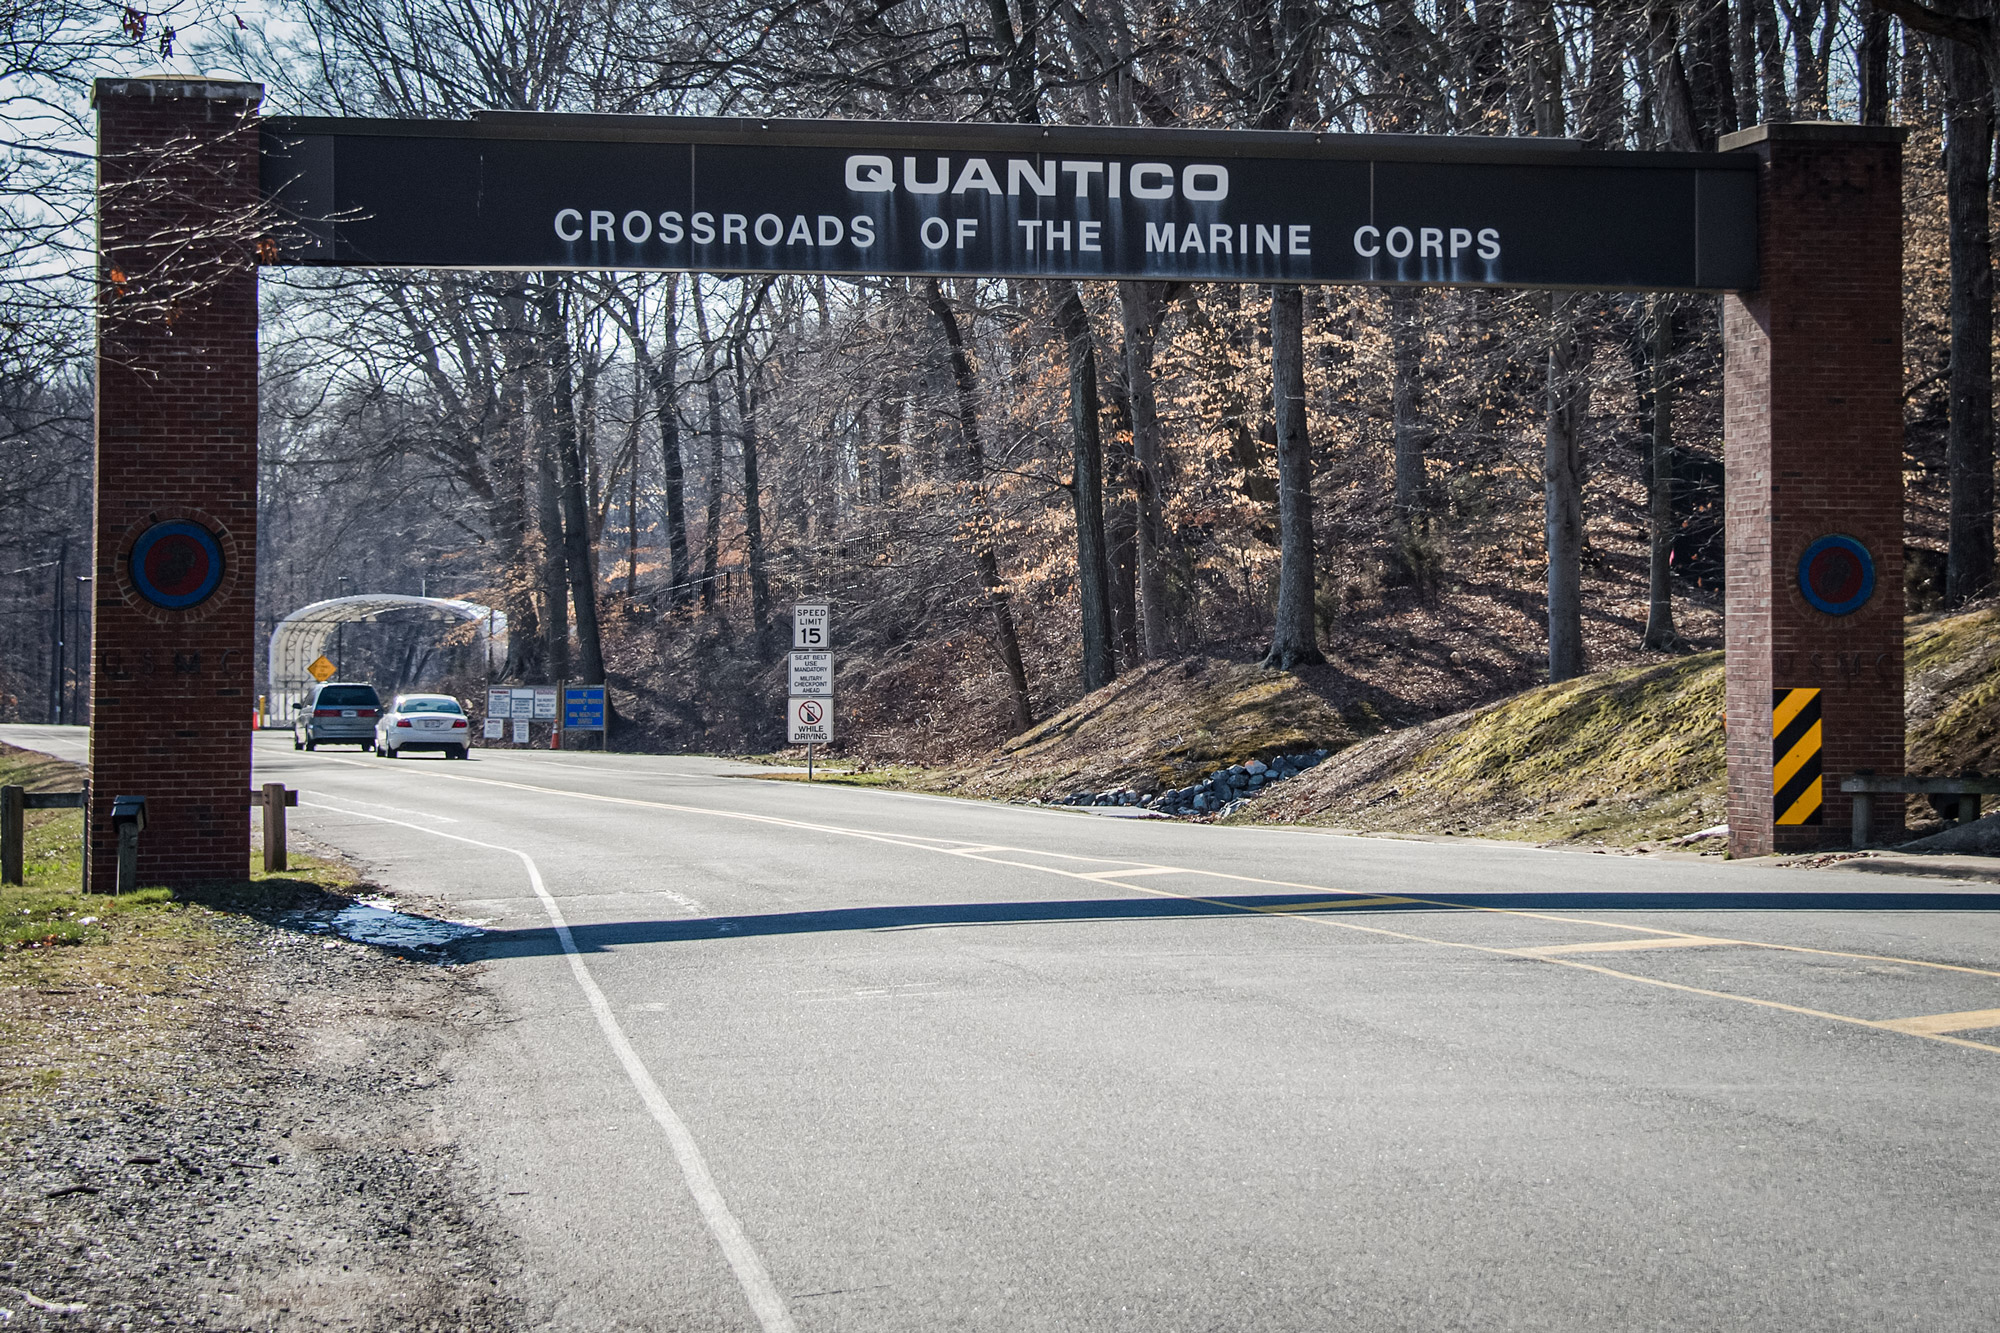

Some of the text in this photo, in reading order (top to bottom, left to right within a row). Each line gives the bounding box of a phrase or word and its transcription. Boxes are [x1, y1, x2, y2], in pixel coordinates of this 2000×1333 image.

[844, 155, 1230, 201] QUANTICO
[554, 208, 1501, 260] CROSSROADS OF THE MARINE CORPS
[797, 609, 827, 617] SPEED
[801, 628, 821, 644] 15
[798, 725, 824, 733] WHILE
[794, 732, 828, 740] DRIVING
